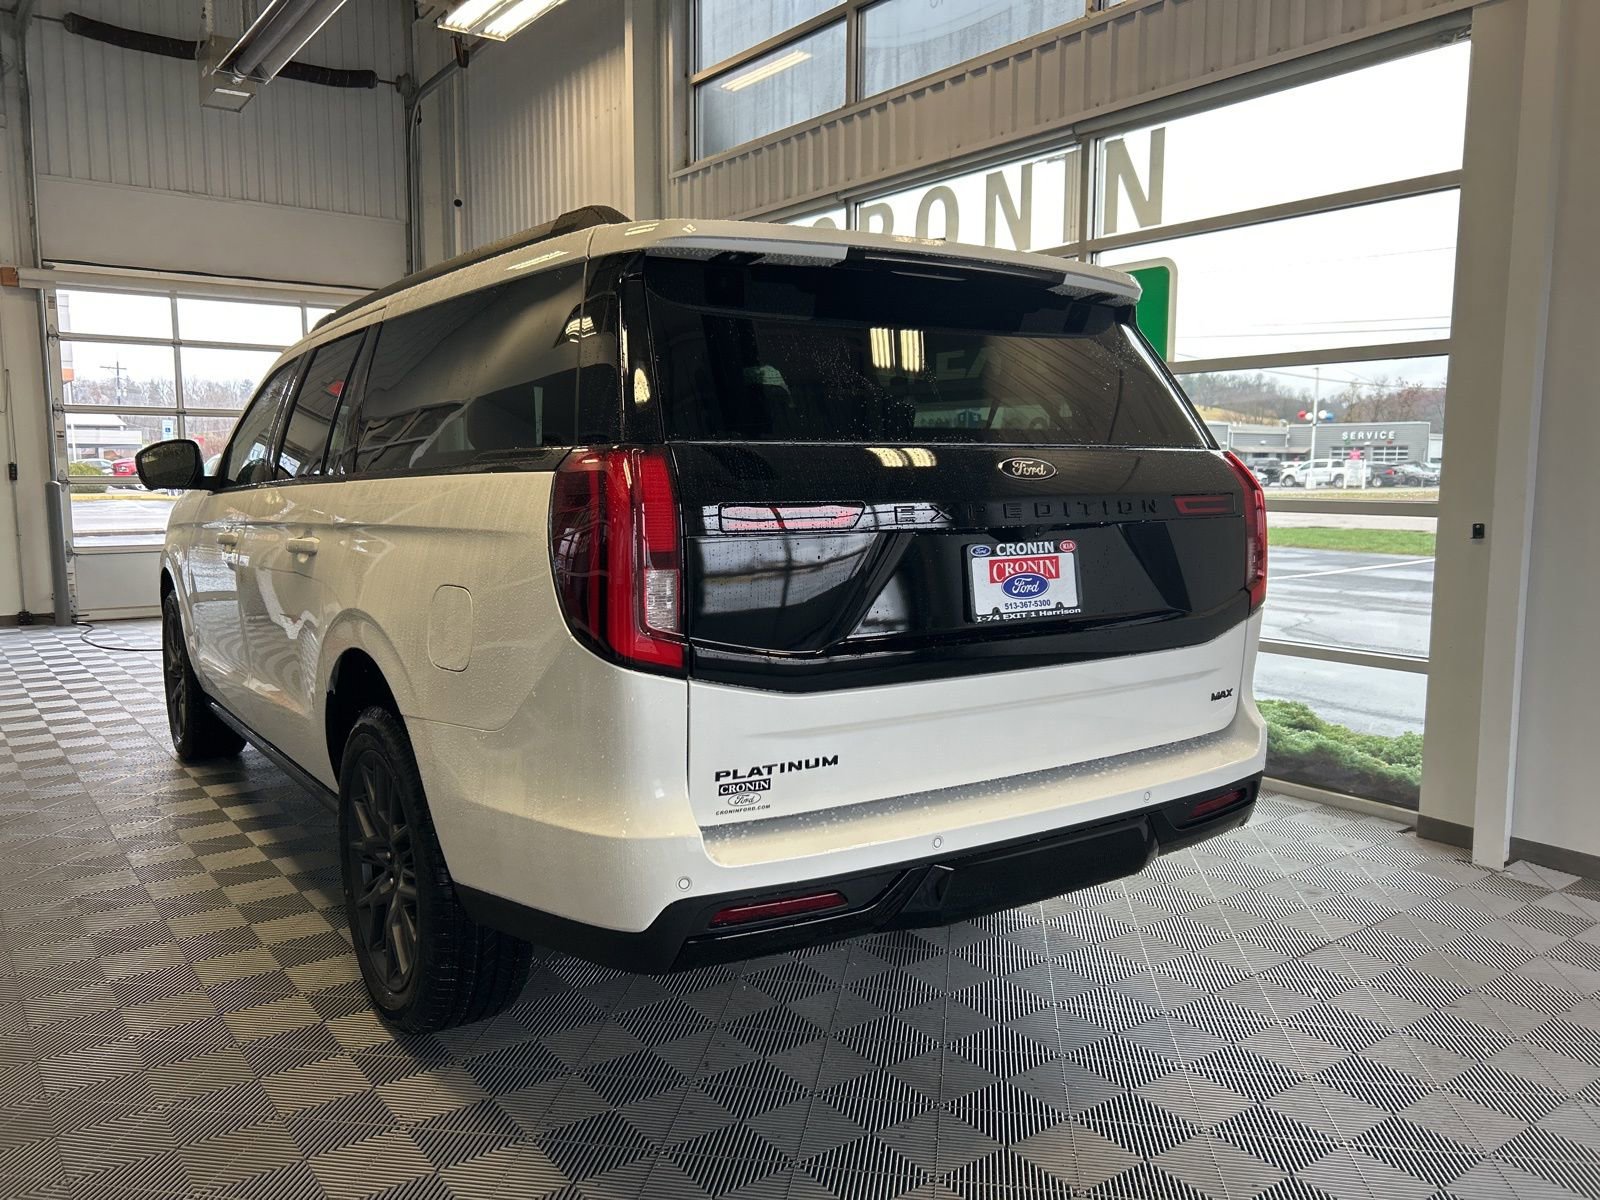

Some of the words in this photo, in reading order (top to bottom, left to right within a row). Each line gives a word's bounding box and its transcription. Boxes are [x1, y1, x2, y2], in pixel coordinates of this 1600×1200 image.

[812, 127, 1166, 251] ONIN
[1342, 431, 1395, 440] SERVICE
[1011, 459, 1047, 477] Ford
[893, 499, 1157, 524] EXPEDITION
[996, 541, 1055, 556] CRONIN
[992, 559, 1057, 582] CRONIN
[1011, 577, 1040, 593] Ford
[1004, 600, 1051, 610] 513-367-5300
[976, 614, 1000, 623] I-74
[1002, 612, 1027, 620] EXIT
[1030, 610, 1037, 618] 1
[1039, 607, 1082, 617] Harrison
[1210, 688, 1233, 701] MAX
[715, 755, 839, 782] PLATINUM
[719, 780, 770, 795] CRONIN
[715, 804, 771, 816] CRONINFORD.COM
